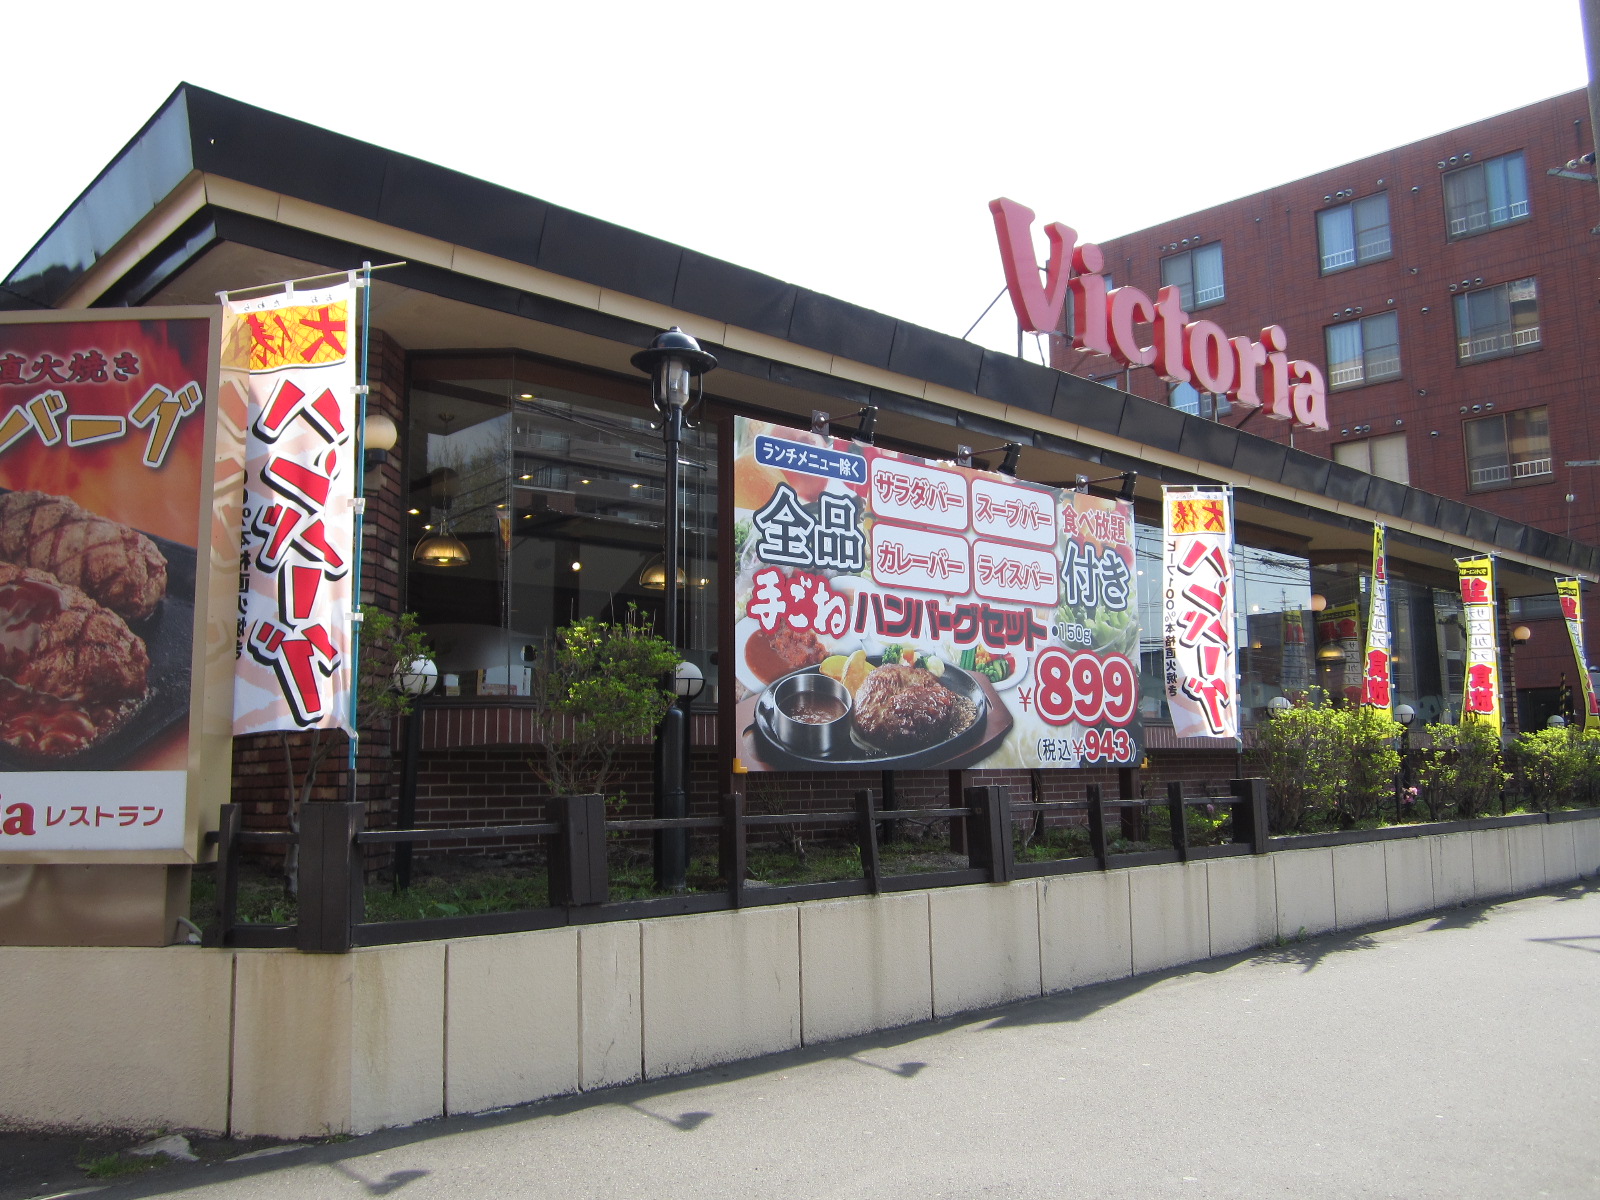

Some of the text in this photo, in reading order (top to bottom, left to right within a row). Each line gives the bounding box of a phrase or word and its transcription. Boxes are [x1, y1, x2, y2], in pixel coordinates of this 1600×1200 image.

[989, 197, 1330, 432] Victoria
[0, 350, 140, 384] 直火焼き
[762, 441, 861, 478] ランチメニュー除く
[875, 470, 966, 510] サラダバー
[754, 482, 866, 572] 全品
[975, 492, 1054, 529] スープバー
[1061, 504, 1128, 544] 食べ放題
[876, 540, 966, 580] カレーバー
[976, 554, 1055, 590] ライスバー
[1060, 538, 1132, 611] 付き
[747, 567, 851, 640] 手ごね
[854, 590, 1048, 652] ハンバーグセット
[46, 806, 164, 827] レストラン
